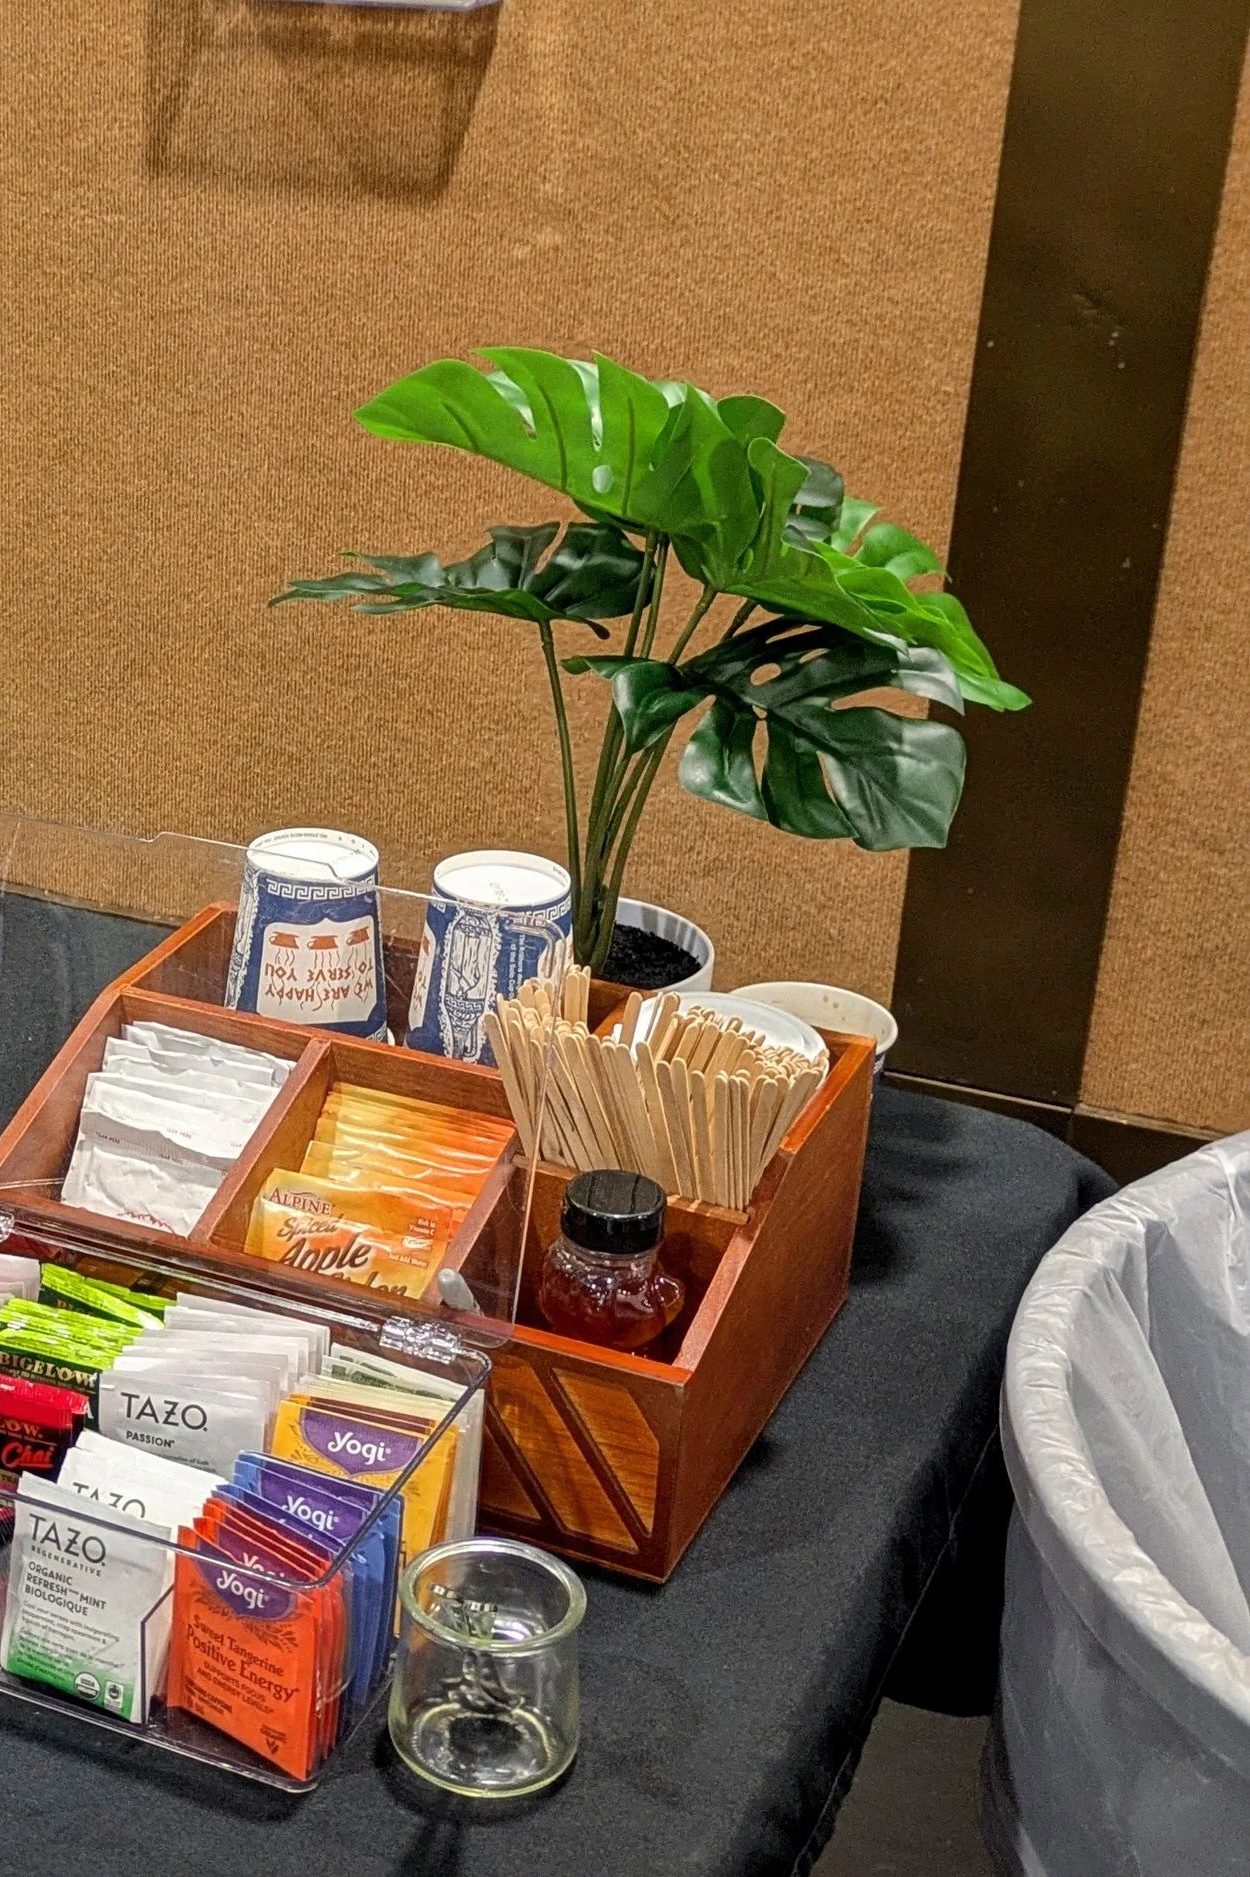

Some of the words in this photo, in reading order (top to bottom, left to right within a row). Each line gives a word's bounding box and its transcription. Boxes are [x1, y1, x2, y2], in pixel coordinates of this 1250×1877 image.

[264, 963, 298, 982] YOU
[307, 967, 350, 983] SERVE
[358, 957, 373, 974] TO
[264, 982, 315, 1002] HAPPY
[324, 985, 350, 1001] ARE
[270, 1187, 332, 1216] ALPINE
[120, 1392, 208, 1431] TAZO
[2, 1441, 54, 1469] Chai
[29, 1513, 107, 1567] TAZO
[28, 1561, 74, 1586] ORGANIC
[31, 1545, 102, 1577] REGENERATIVE
[24, 1584, 89, 1617] BIOLOGIQUE
[79, 1592, 107, 1610] MINT
[193, 1614, 224, 1646] Sweet
[226, 1635, 284, 1677] Tangerine
[186, 1623, 238, 1672] Positive
[239, 1660, 297, 1702] Energy
